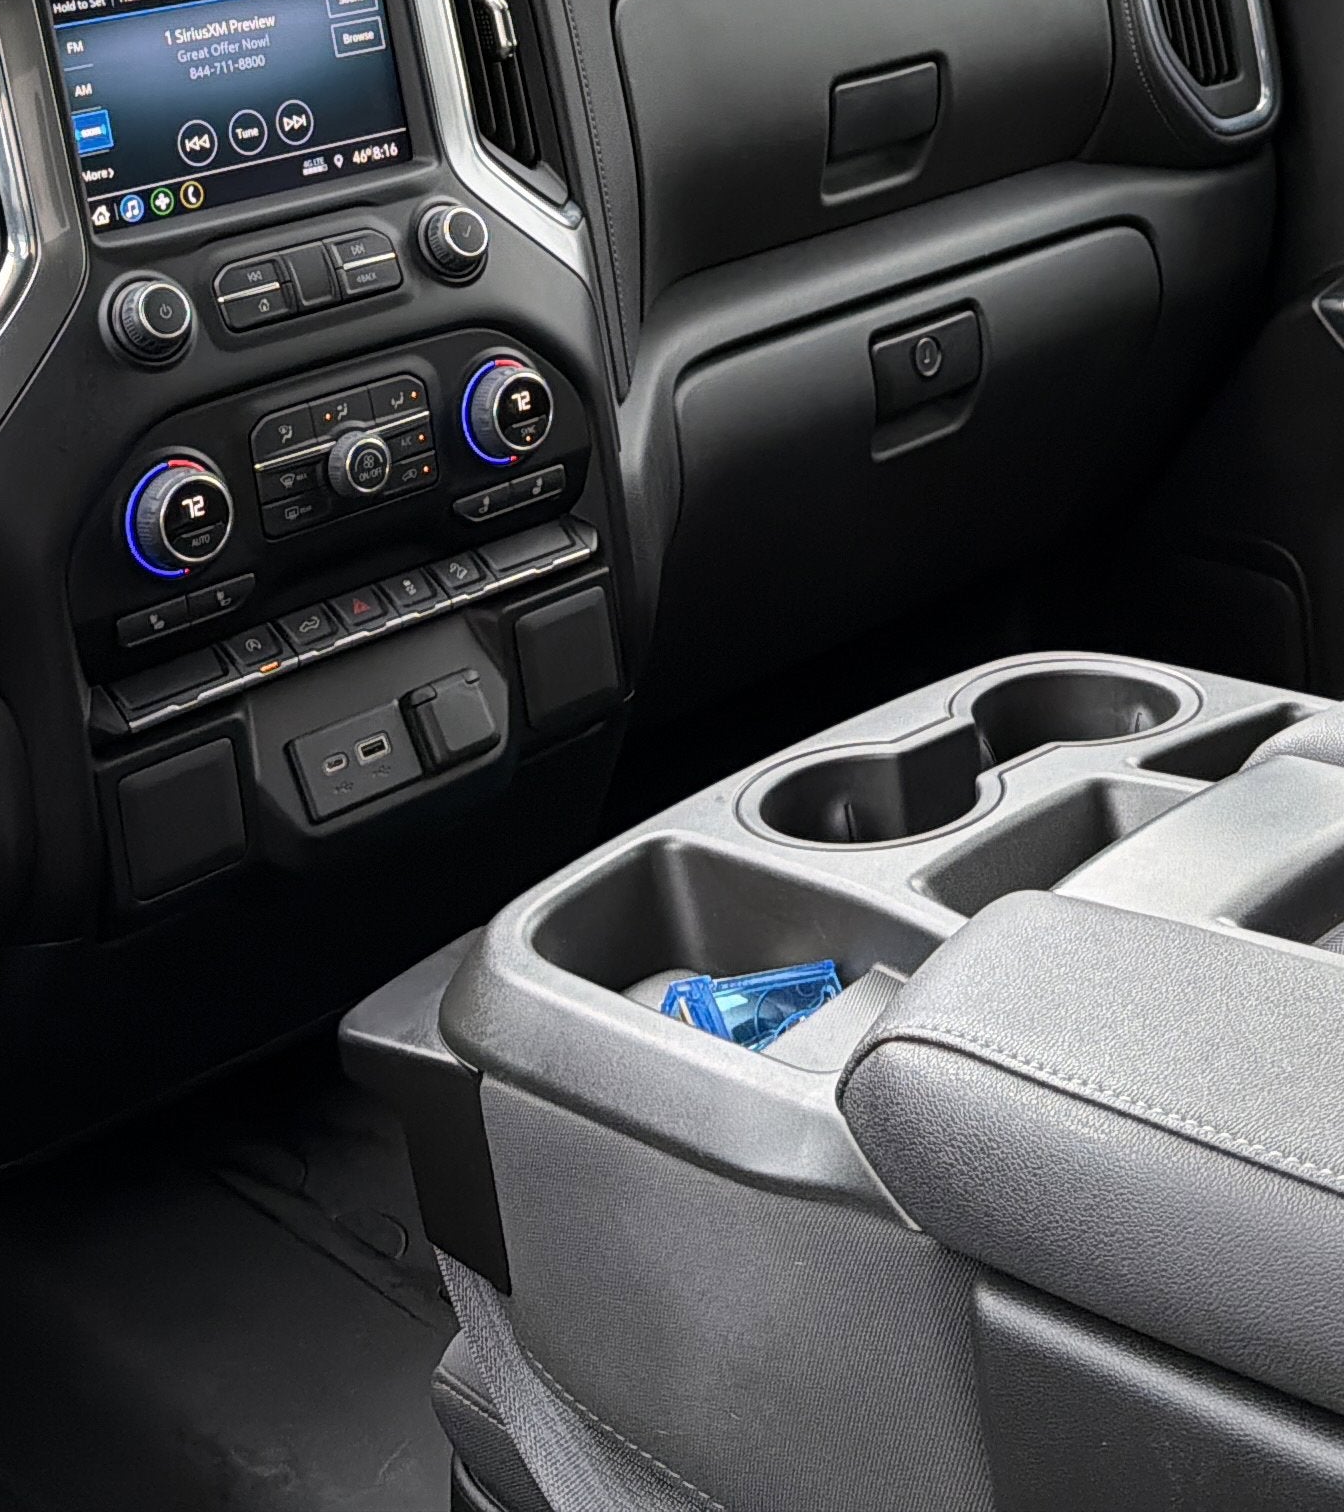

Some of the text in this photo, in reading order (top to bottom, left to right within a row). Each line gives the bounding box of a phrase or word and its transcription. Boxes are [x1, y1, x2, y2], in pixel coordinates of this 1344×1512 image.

[53, 0, 76, 14] Hold
[165, 16, 276, 45] 1 SiriusXM Preview
[342, 31, 375, 44] Browse
[66, 40, 84, 54] FM
[177, 33, 271, 63] Great Offer Now!
[189, 54, 266, 80] 844-711-8800
[74, 83, 93, 97] AM
[236, 126, 259, 140] Tune
[372, 142, 398, 161] 8:16
[511, 390, 531, 412] 72
[359, 467, 383, 483] ON/OFF
[181, 494, 206, 519] 72
[191, 533, 211, 547] AUTO
